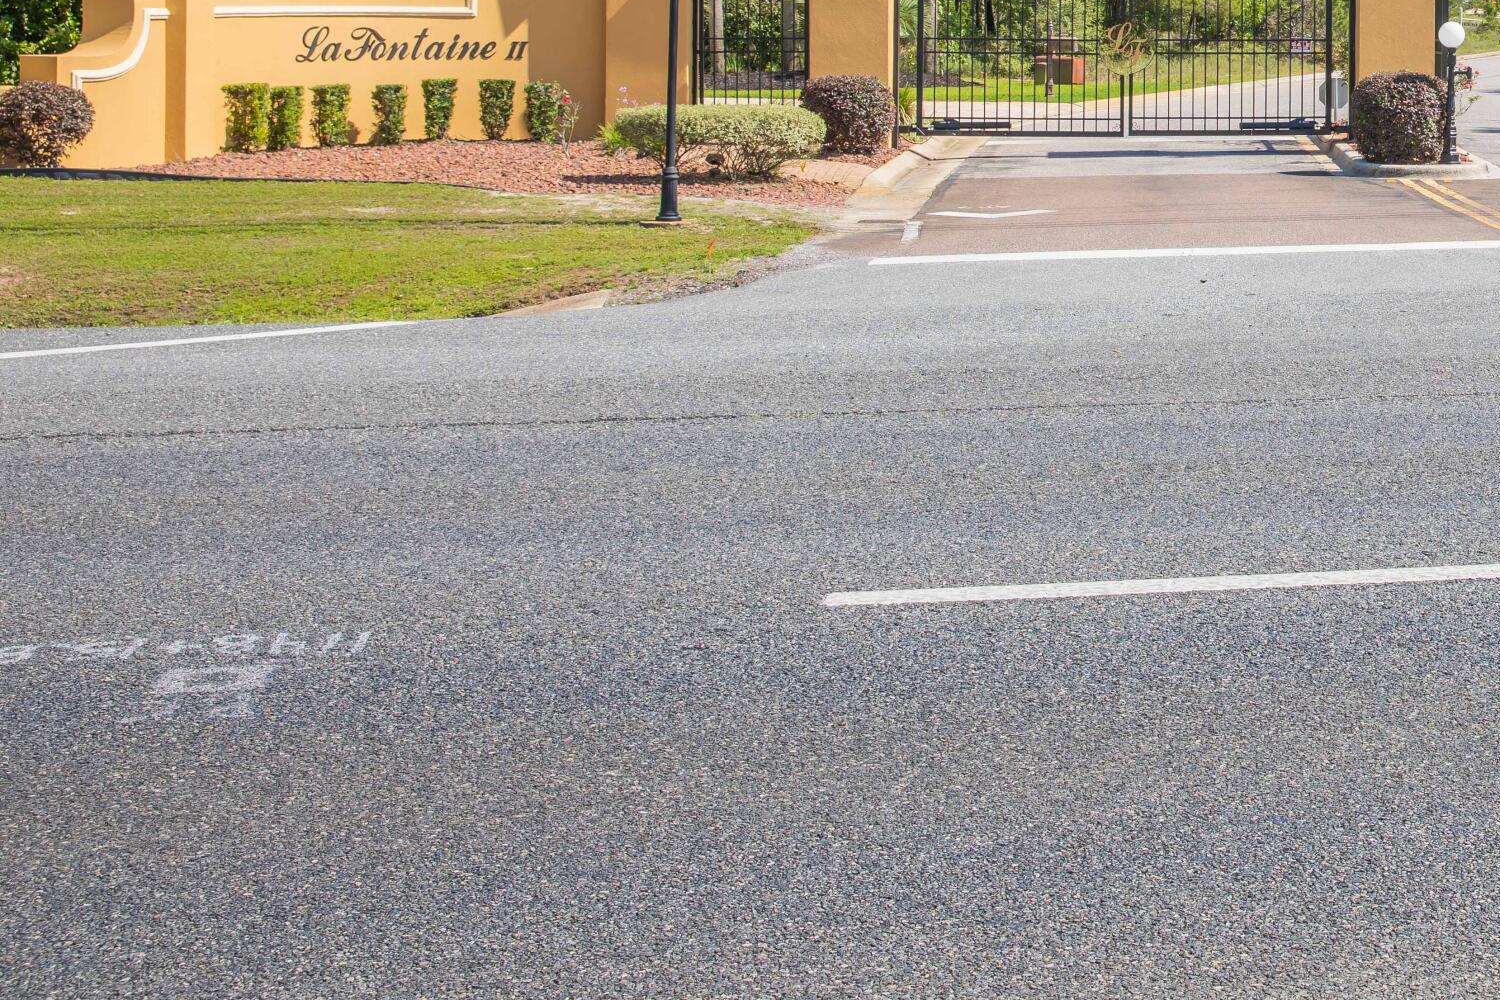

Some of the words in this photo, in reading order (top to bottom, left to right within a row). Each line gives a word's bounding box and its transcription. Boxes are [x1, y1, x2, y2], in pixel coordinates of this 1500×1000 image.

[295, 26, 342, 63] La
[344, 26, 497, 62] Fontaine
[504, 41, 528, 61] II
